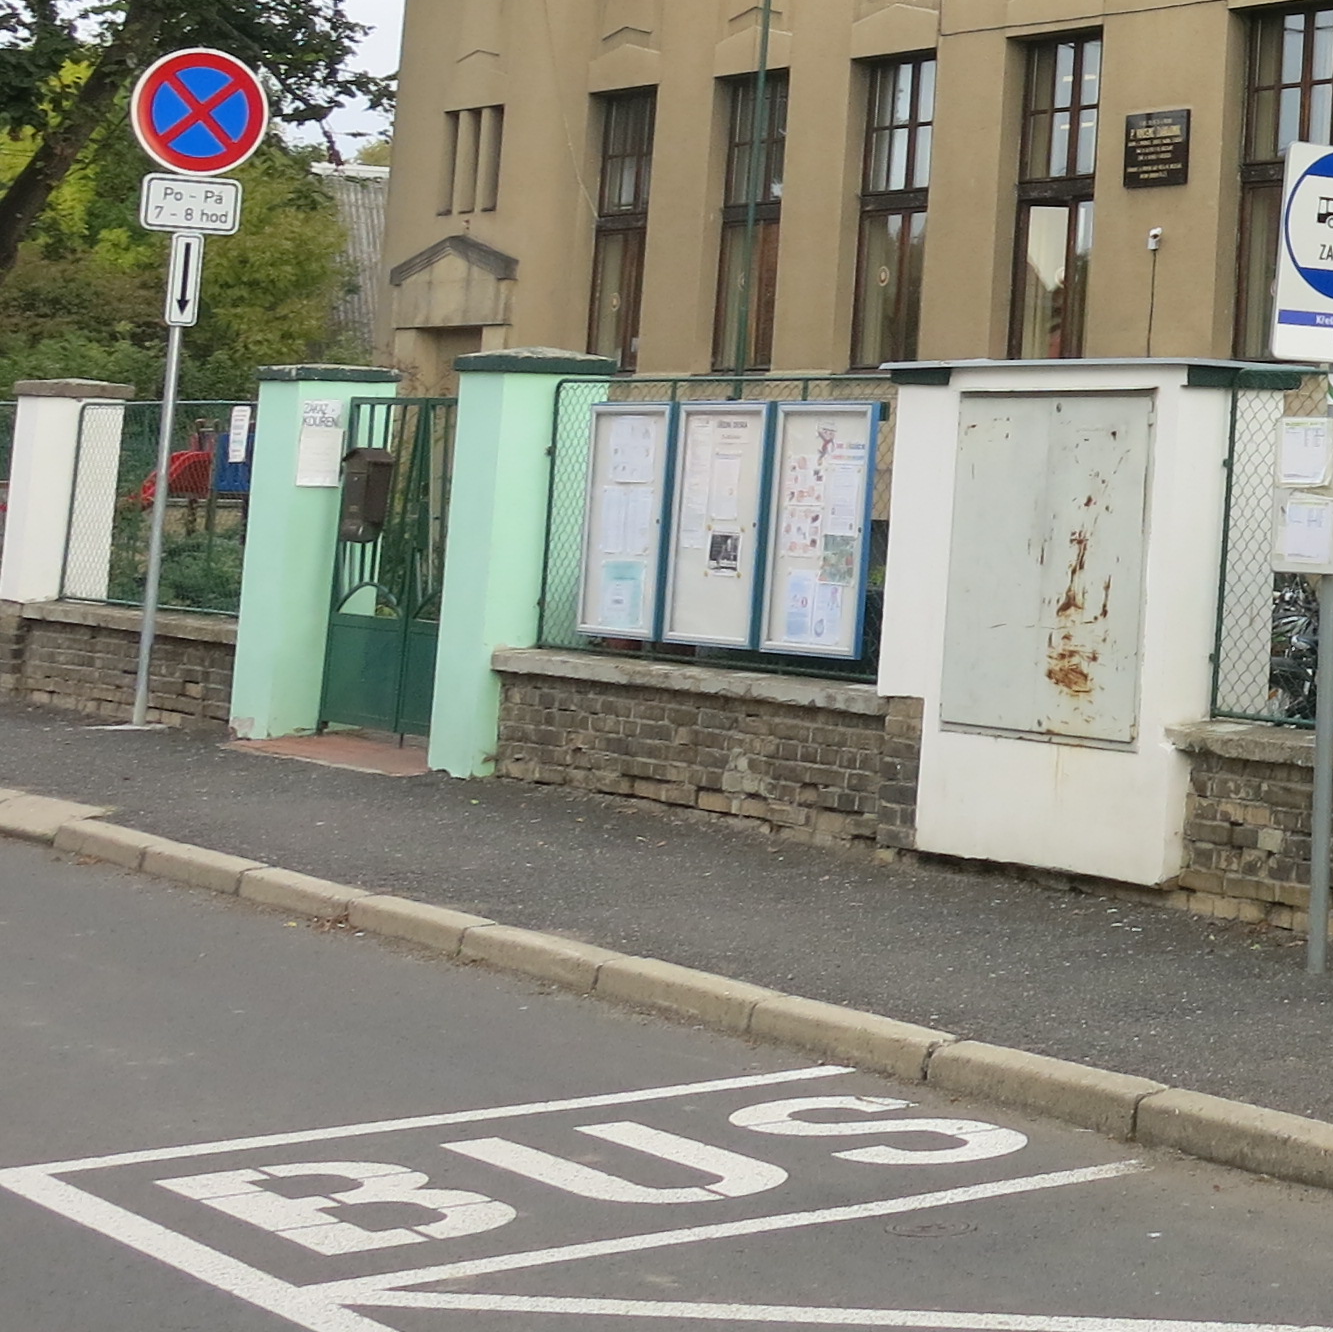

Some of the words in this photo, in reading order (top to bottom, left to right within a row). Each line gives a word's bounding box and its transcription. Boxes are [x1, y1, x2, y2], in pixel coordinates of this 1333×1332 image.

[163, 186, 183, 201] Po
[203, 189, 223, 205] Pá
[154, 205, 164, 219] 7
[184, 208, 194, 221] 8
[200, 209, 229, 224] hod
[154, 1095, 1029, 1256] BUS
